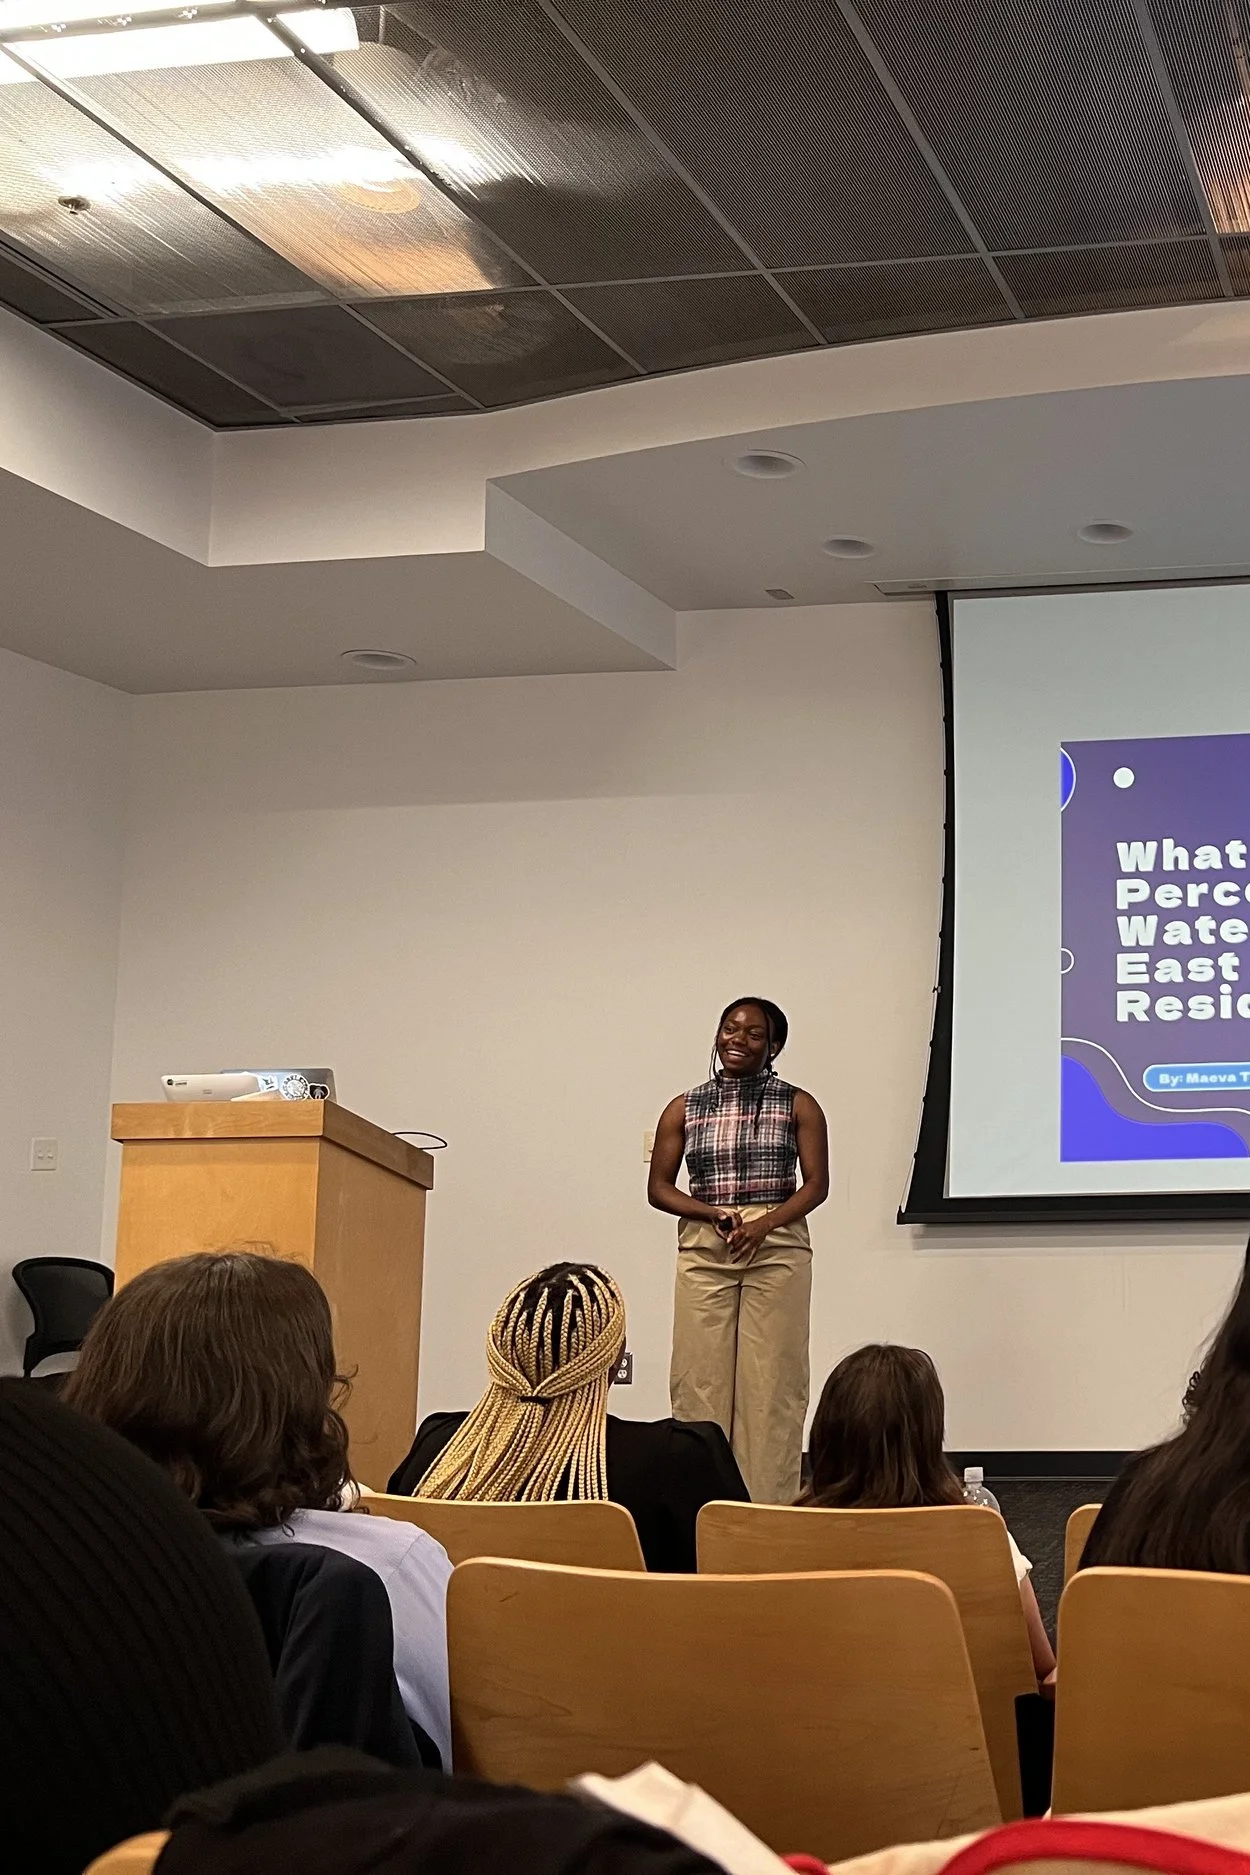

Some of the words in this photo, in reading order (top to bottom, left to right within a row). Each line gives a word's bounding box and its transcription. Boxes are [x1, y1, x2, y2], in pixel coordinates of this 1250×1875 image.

[1116, 838, 1248, 873] What
[1116, 951, 1240, 985] East
[1159, 1072, 1184, 1087] By:
[1186, 1072, 1237, 1084] Maeva
